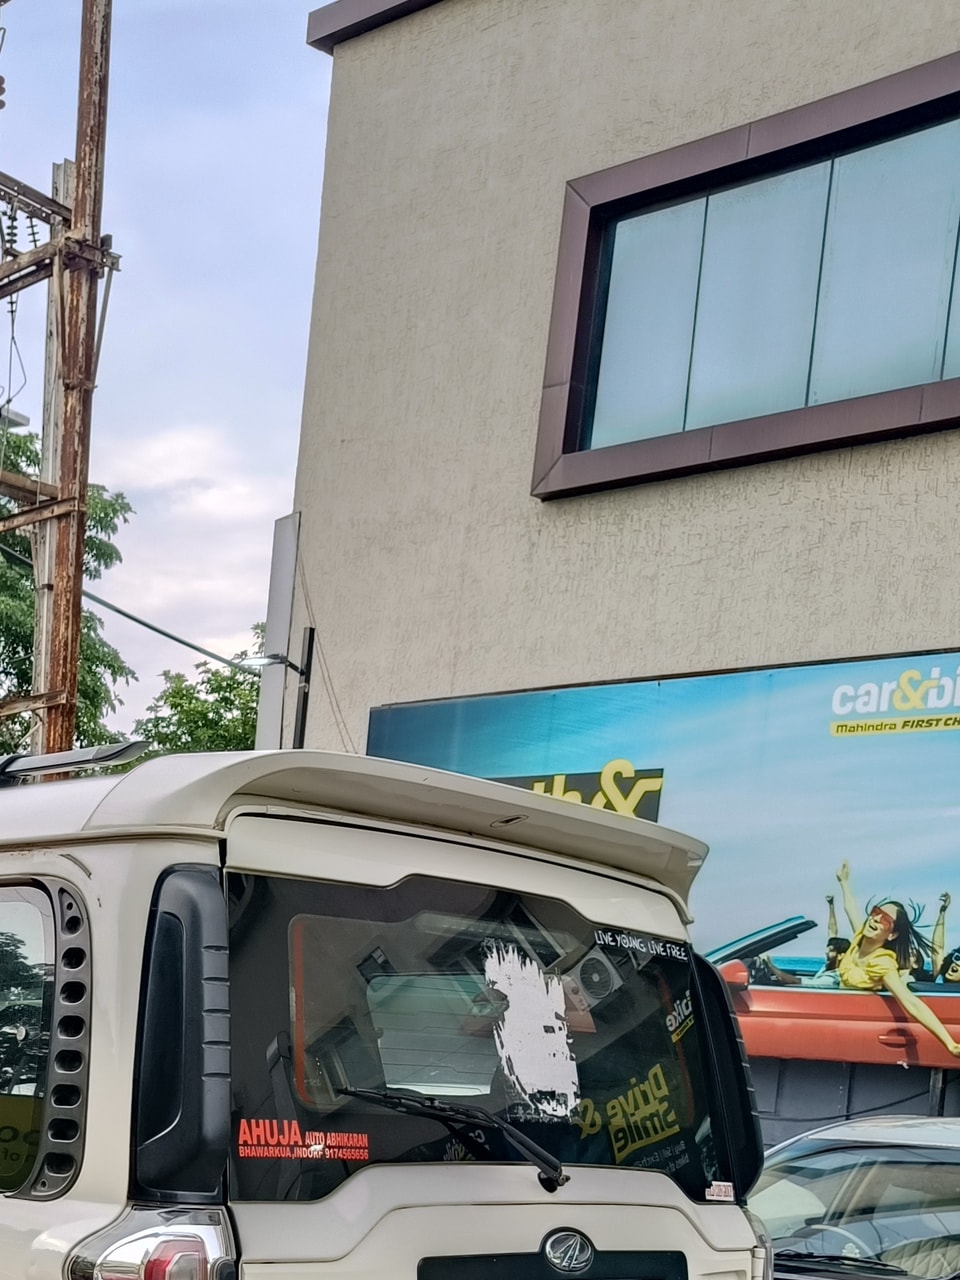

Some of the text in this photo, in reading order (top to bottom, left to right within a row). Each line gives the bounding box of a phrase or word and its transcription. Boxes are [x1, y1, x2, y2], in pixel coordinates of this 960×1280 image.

[901, 718, 942, 729] FIRST
[594, 930, 688, 961] LIVE YOUNG LIVE FREE
[238, 1119, 369, 1148] AHUJA AUTO ABHIKARAN
[325, 1147, 369, 1160] 9174565656
